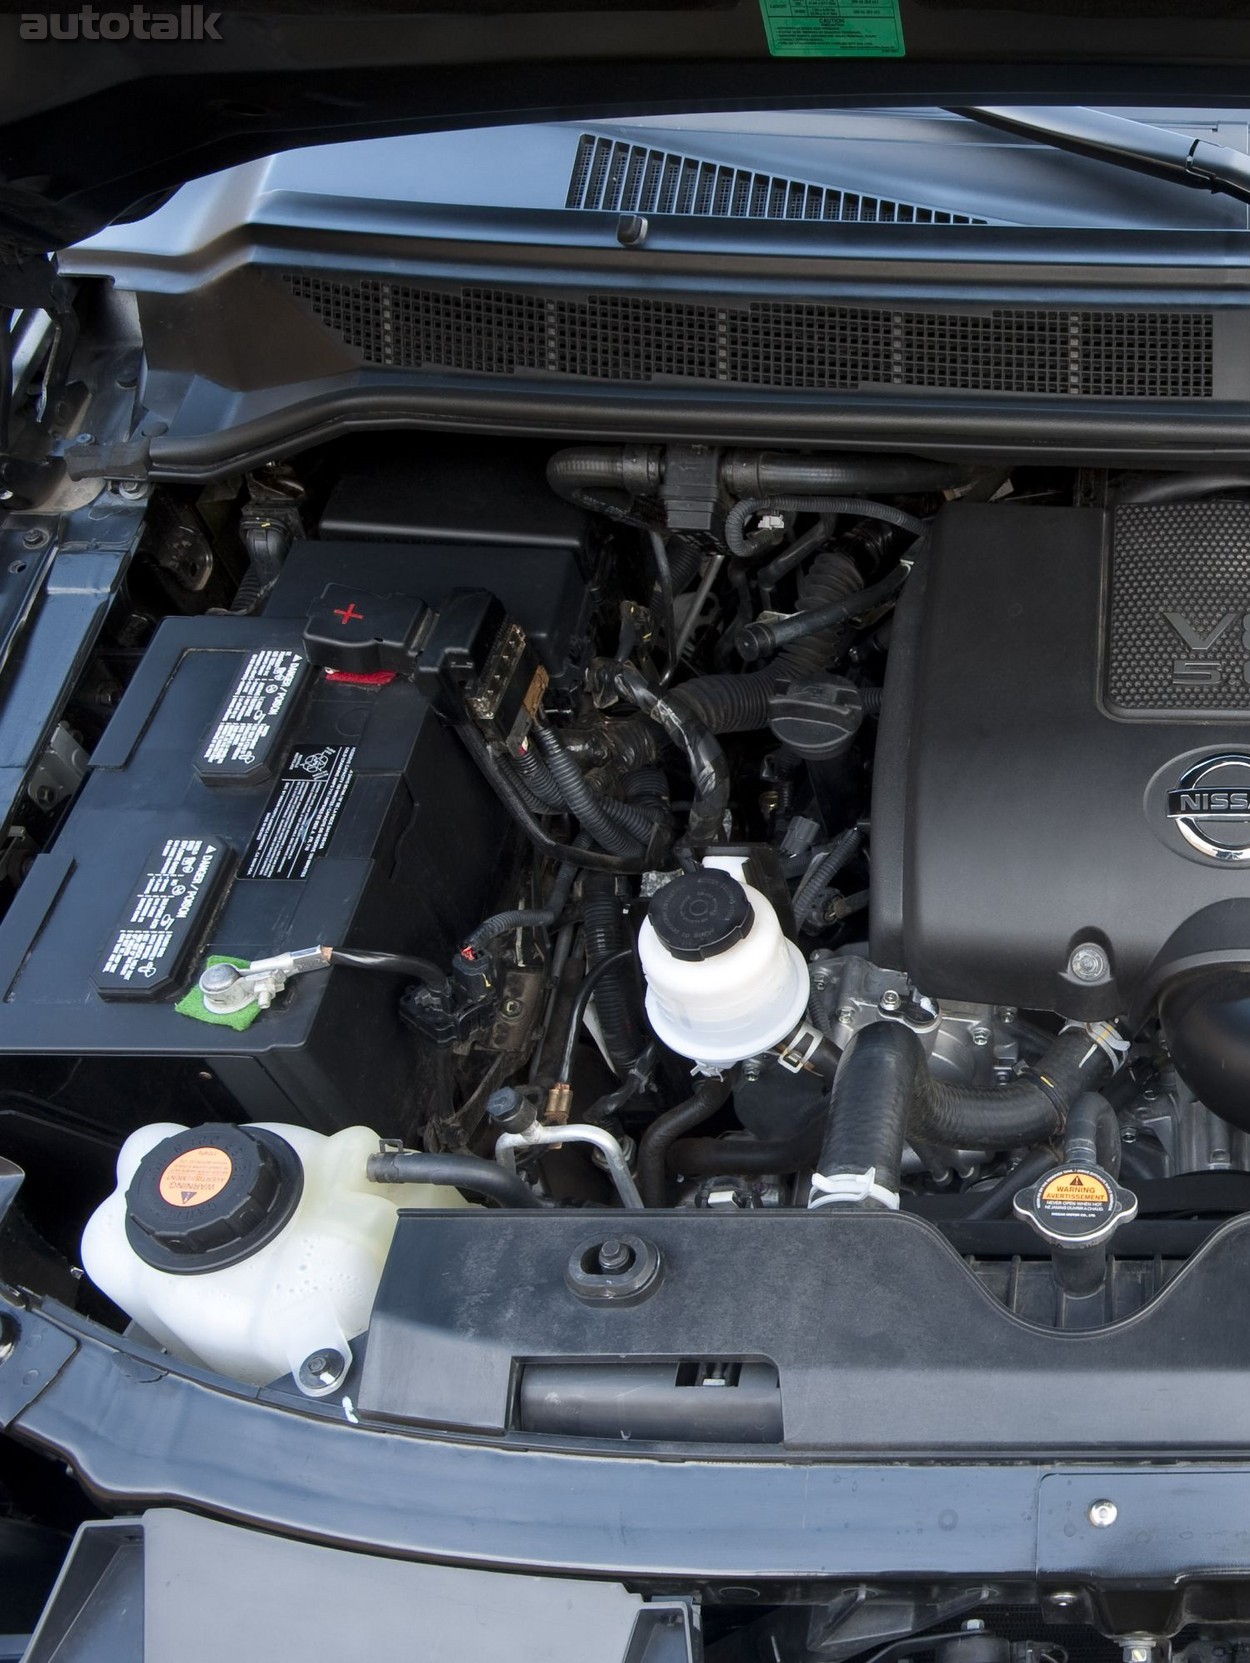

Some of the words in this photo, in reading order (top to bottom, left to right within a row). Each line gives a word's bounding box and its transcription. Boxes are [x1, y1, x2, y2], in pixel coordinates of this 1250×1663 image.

[281, 663, 299, 687] DANGER
[268, 692, 286, 715] POISON
[191, 855, 213, 884] DANGER
[176, 890, 197, 918] POISON
[168, 1182, 215, 1190] WARNING
